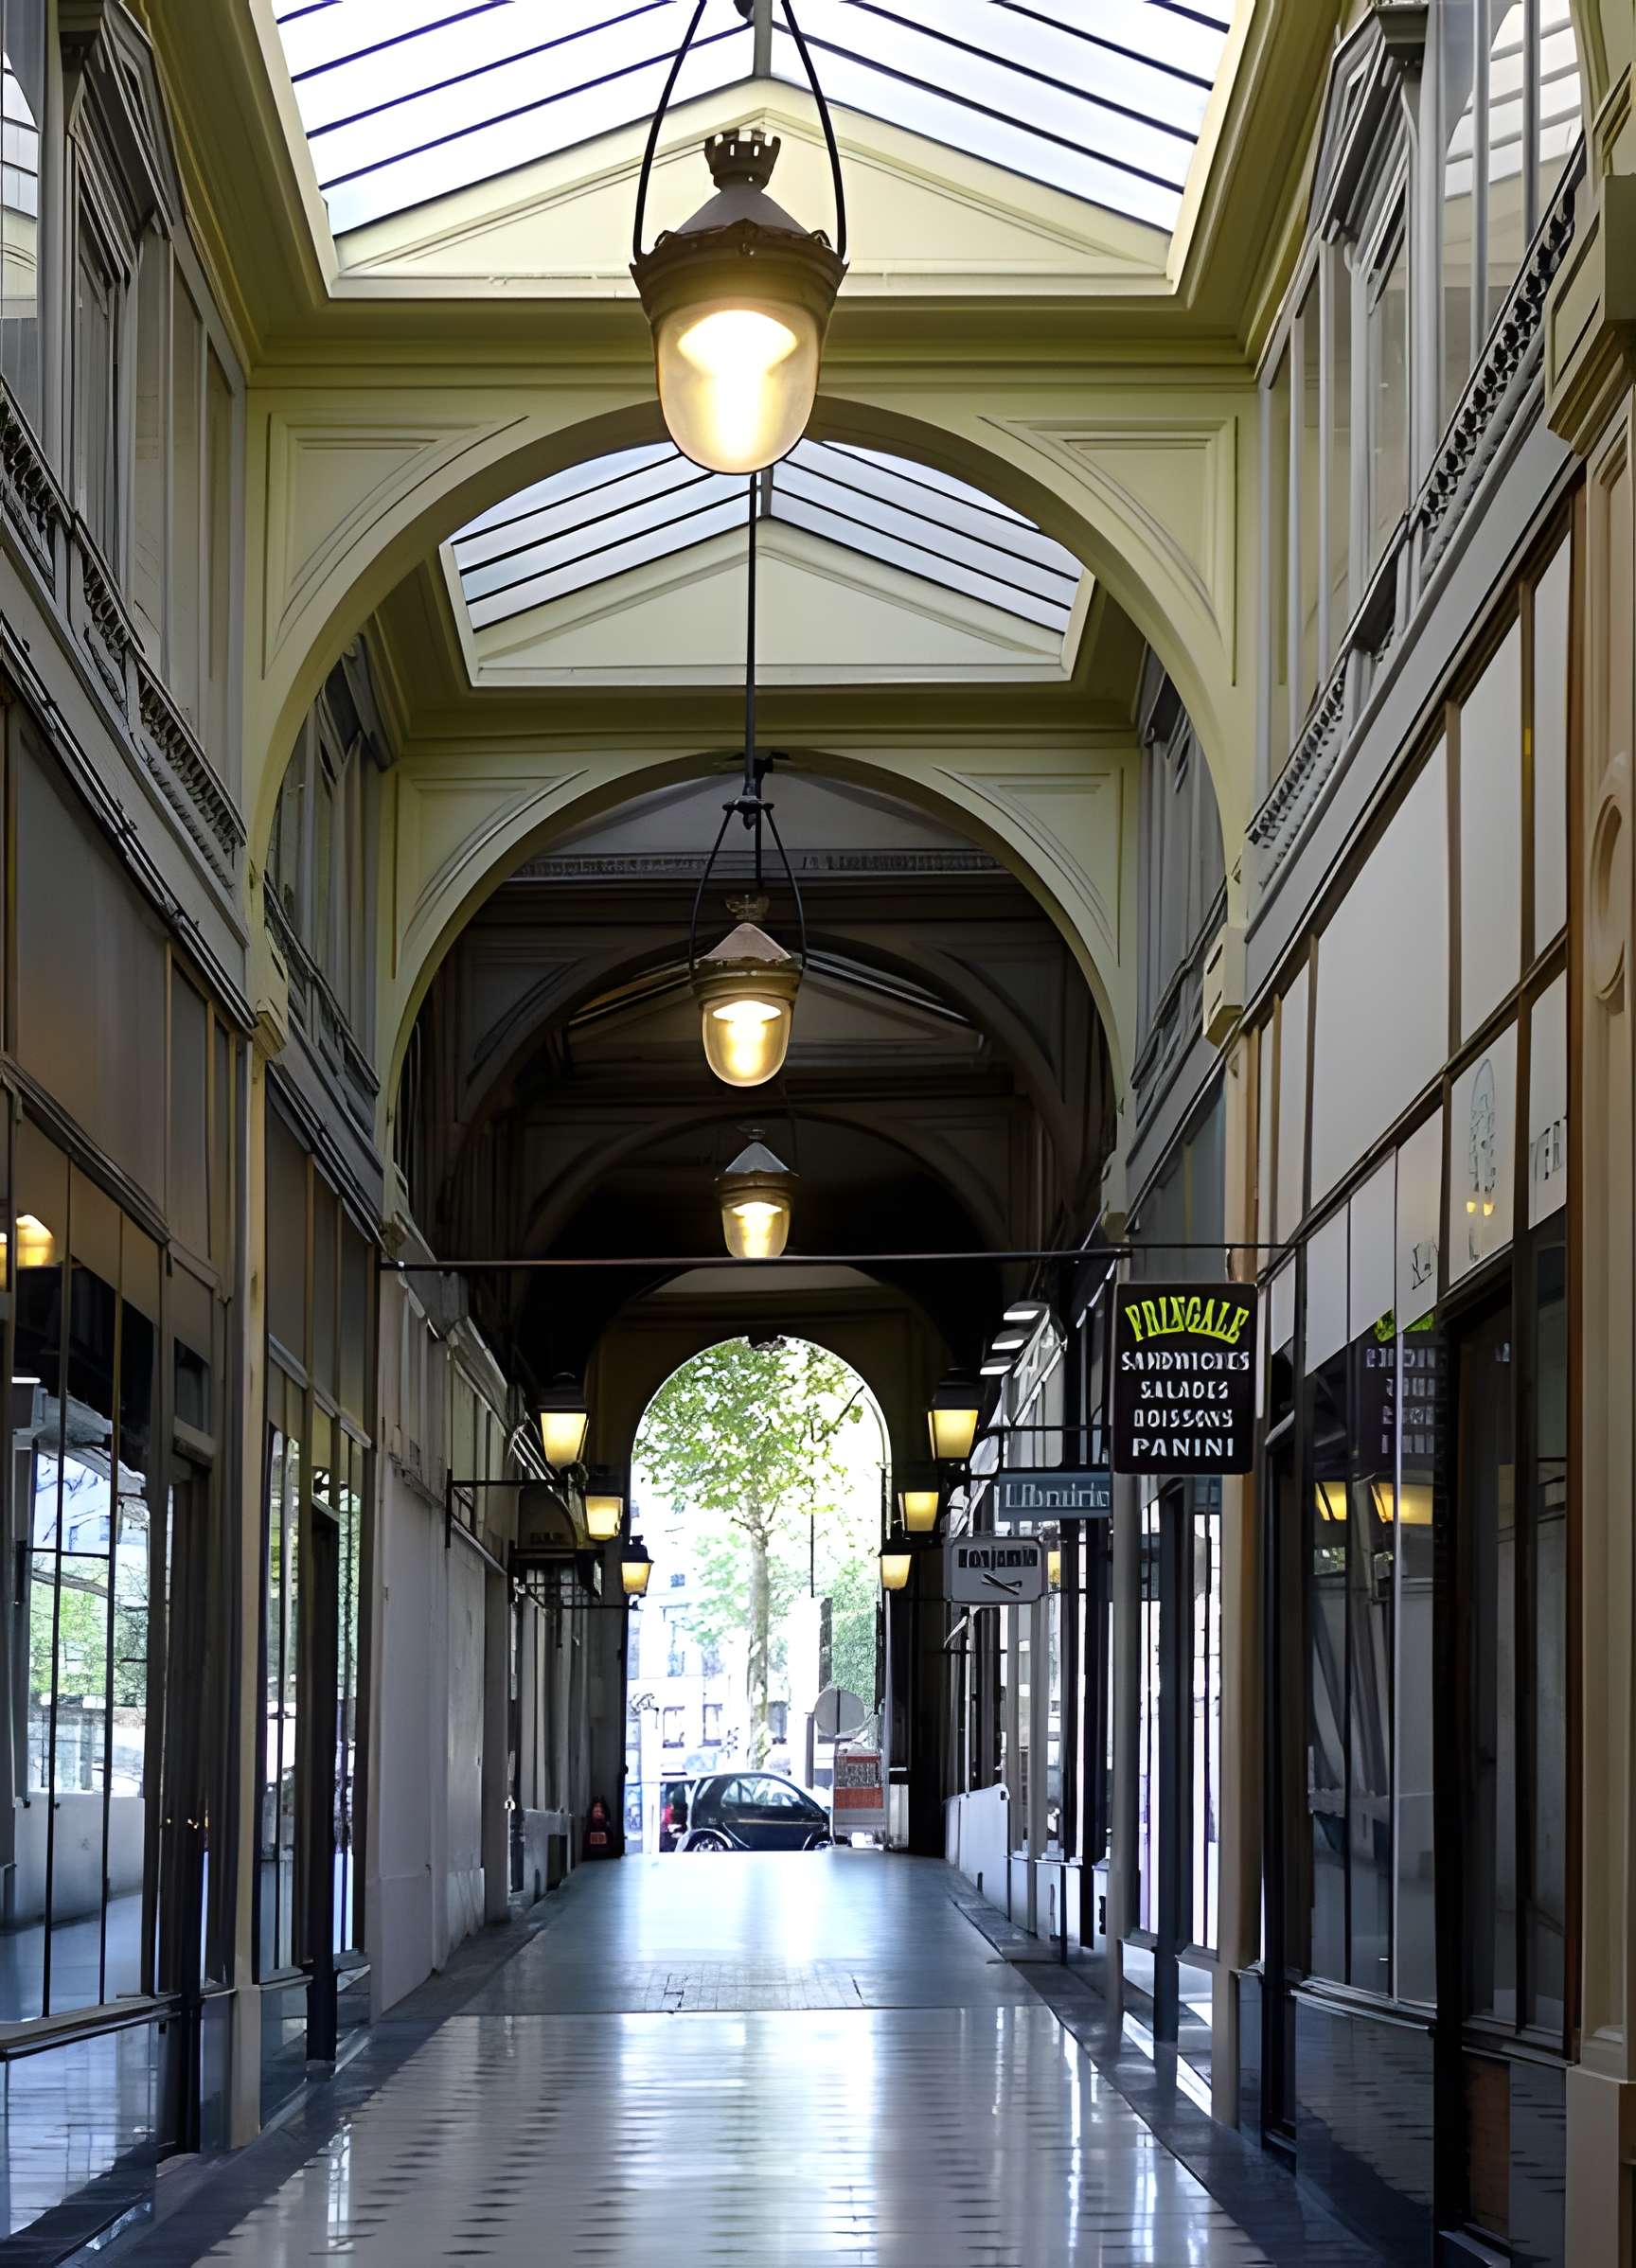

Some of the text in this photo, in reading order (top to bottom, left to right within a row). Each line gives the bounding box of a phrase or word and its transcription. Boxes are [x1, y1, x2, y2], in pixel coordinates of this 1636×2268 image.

[1141, 1380, 1229, 1399] SALADES
[1133, 1409, 1234, 1427] BOISSONS
[1132, 1438, 1234, 1457] PANINI
